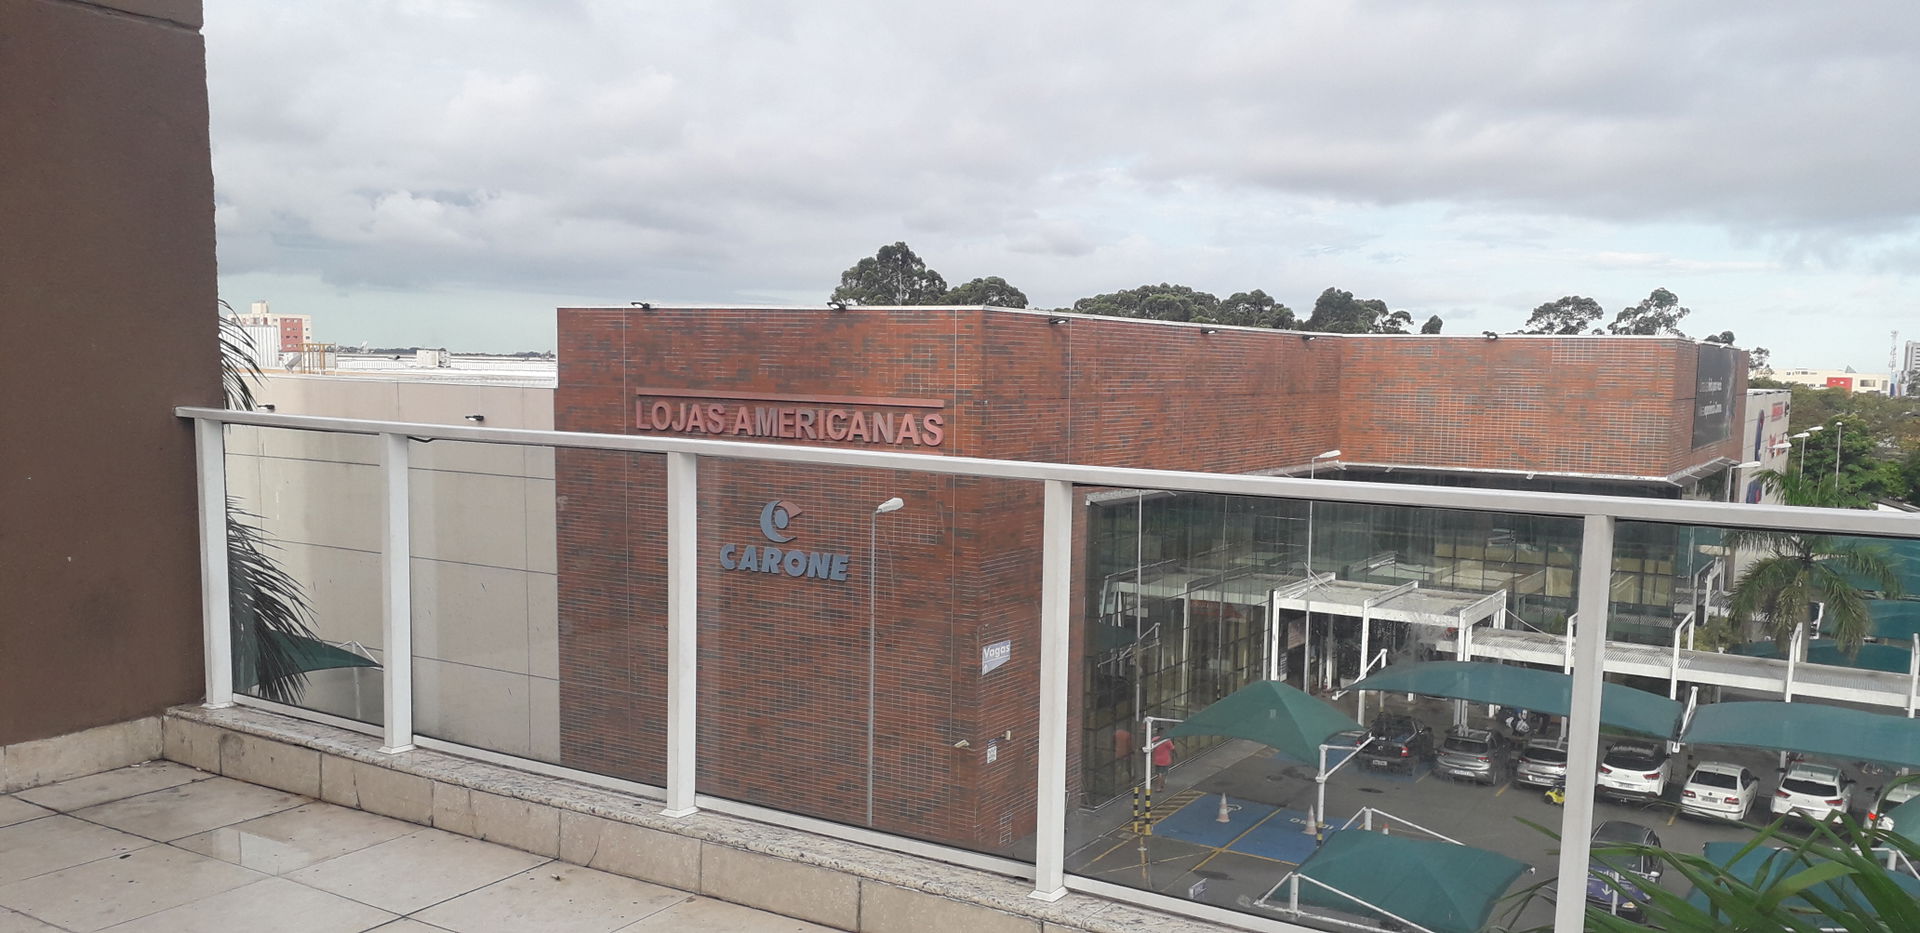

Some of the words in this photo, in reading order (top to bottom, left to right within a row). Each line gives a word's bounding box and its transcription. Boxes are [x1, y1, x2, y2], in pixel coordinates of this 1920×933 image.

[636, 400, 726, 434] LOJAS
[733, 406, 945, 447] AMERICANAS
[719, 543, 850, 582] CARONE
[983, 645, 1010, 659] Vagas
